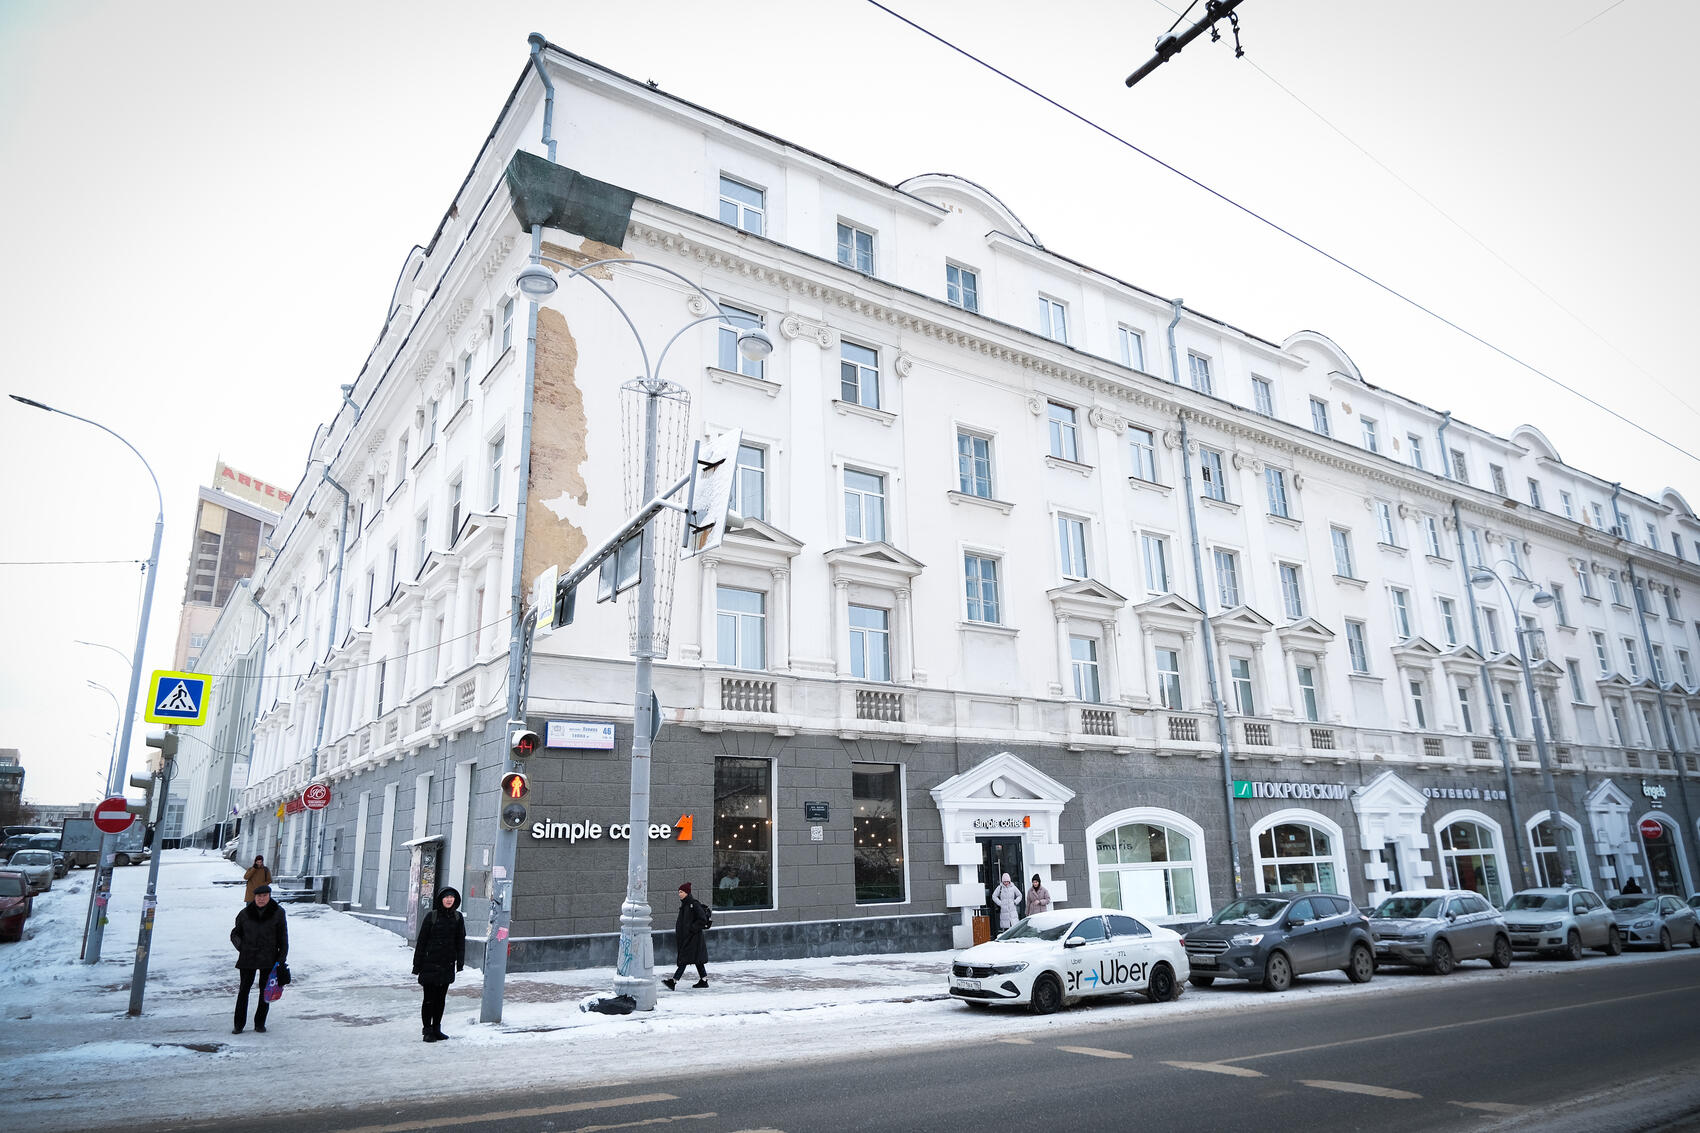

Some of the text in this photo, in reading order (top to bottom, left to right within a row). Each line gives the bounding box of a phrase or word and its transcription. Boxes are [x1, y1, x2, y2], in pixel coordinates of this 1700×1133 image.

[1252, 781, 1348, 800] ПОКРОВСКИЙ
[1422, 787, 1508, 801] ОБУВНОЙ ДОМ
[532, 818, 672, 844] simple coee
[974, 818, 1023, 829] simple coffee
[1100, 959, 1149, 985] Uber
